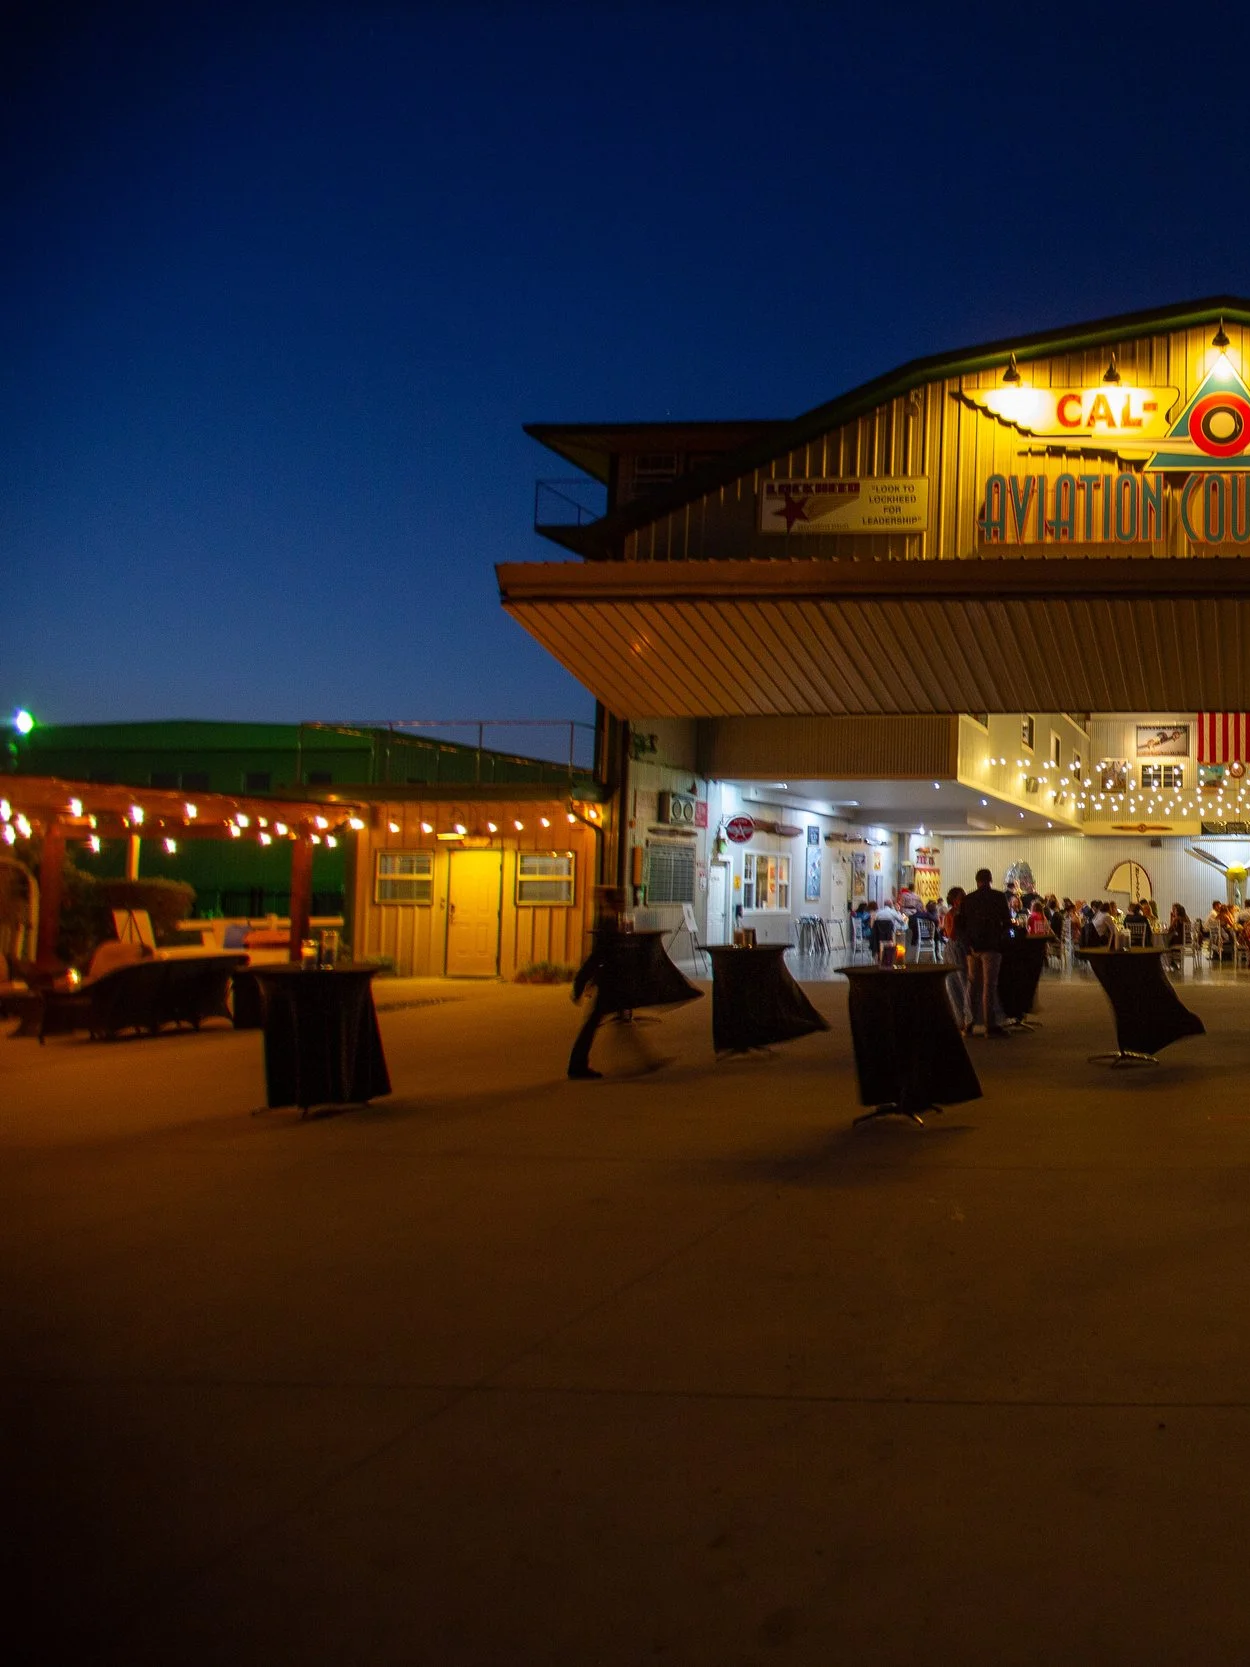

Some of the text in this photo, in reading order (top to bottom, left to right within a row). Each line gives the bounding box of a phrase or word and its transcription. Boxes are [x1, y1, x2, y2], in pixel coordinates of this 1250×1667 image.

[1057, 393, 1158, 428] CAL-
[902, 484, 915, 493] TO
[869, 495, 917, 504] LOCKHEED
[883, 506, 901, 514] FOR
[976, 473, 1163, 545] AVIATION
